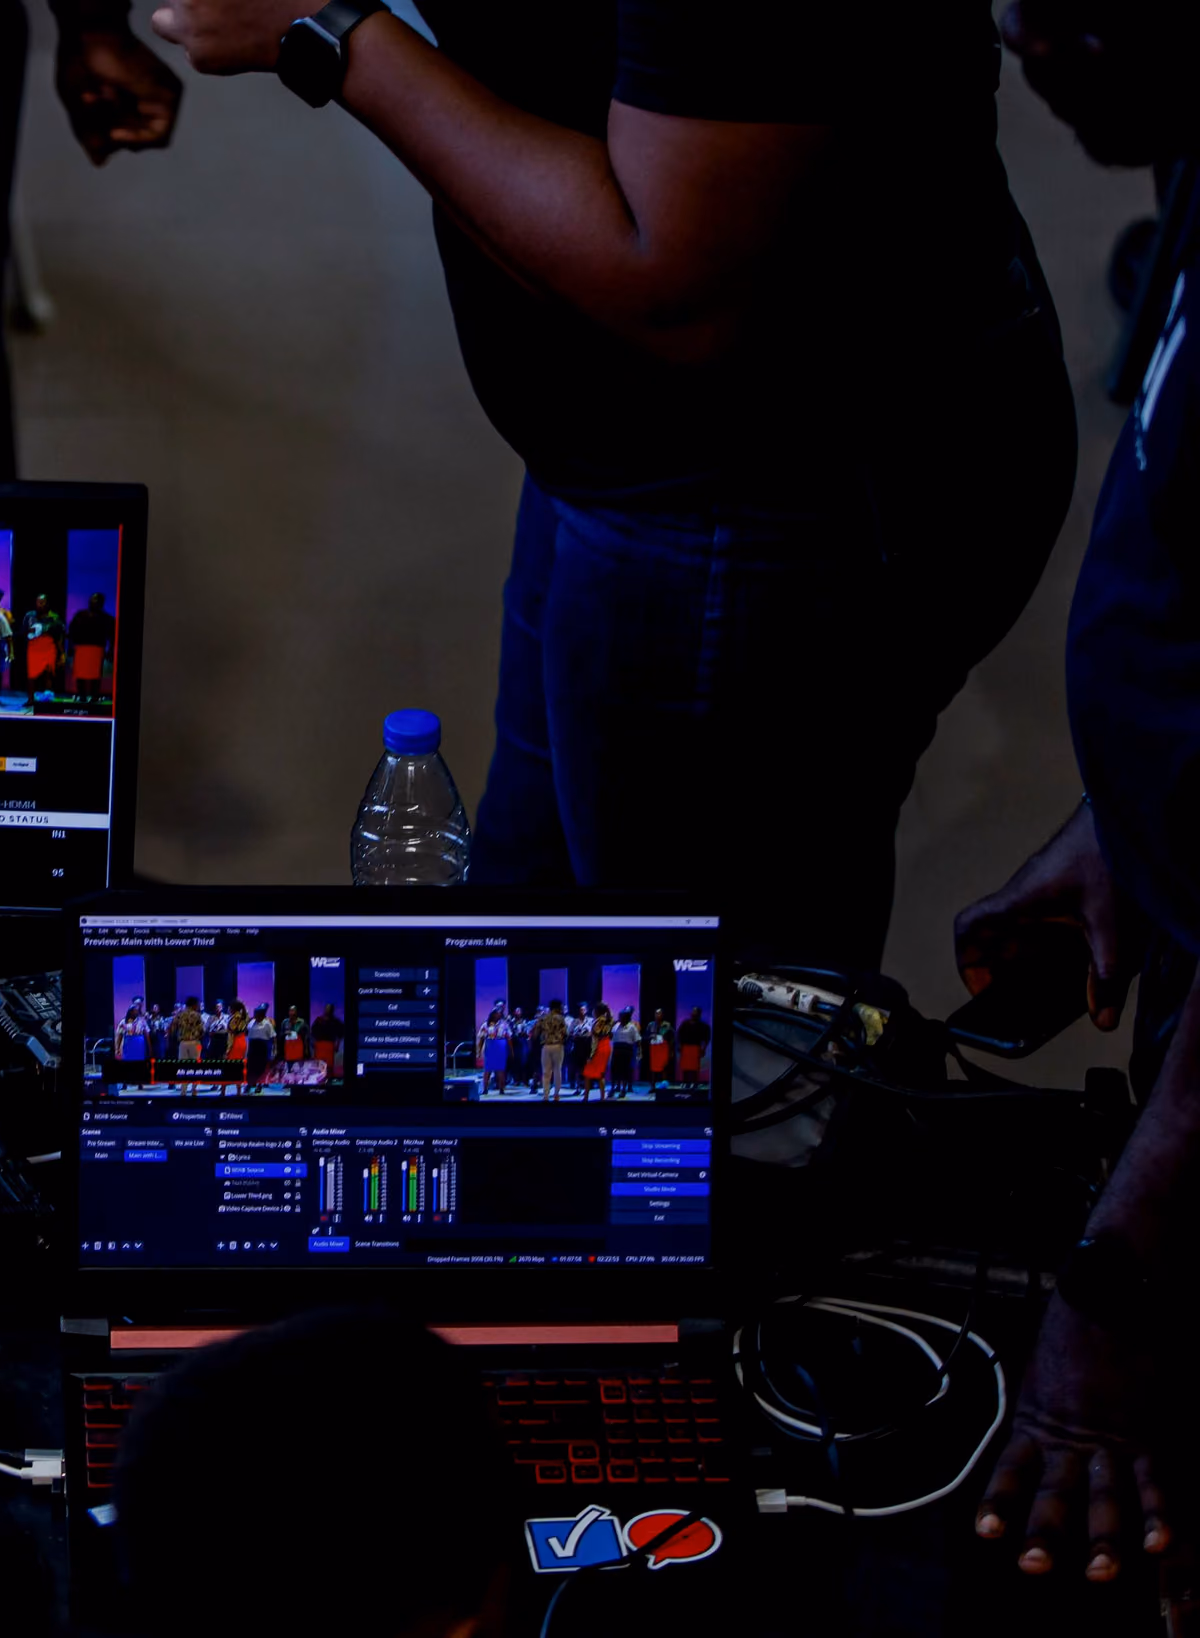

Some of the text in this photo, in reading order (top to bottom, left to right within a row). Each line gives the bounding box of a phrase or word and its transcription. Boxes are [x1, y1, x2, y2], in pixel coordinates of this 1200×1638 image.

[9, 815, 49, 824] STATUS
[51, 829, 66, 838] IN1
[51, 868, 64, 877] 95
[121, 937, 142, 946] Main
[144, 937, 164, 946] with
[165, 937, 191, 947] Lower
[192, 937, 215, 946] Third
[485, 937, 508, 947] Main
